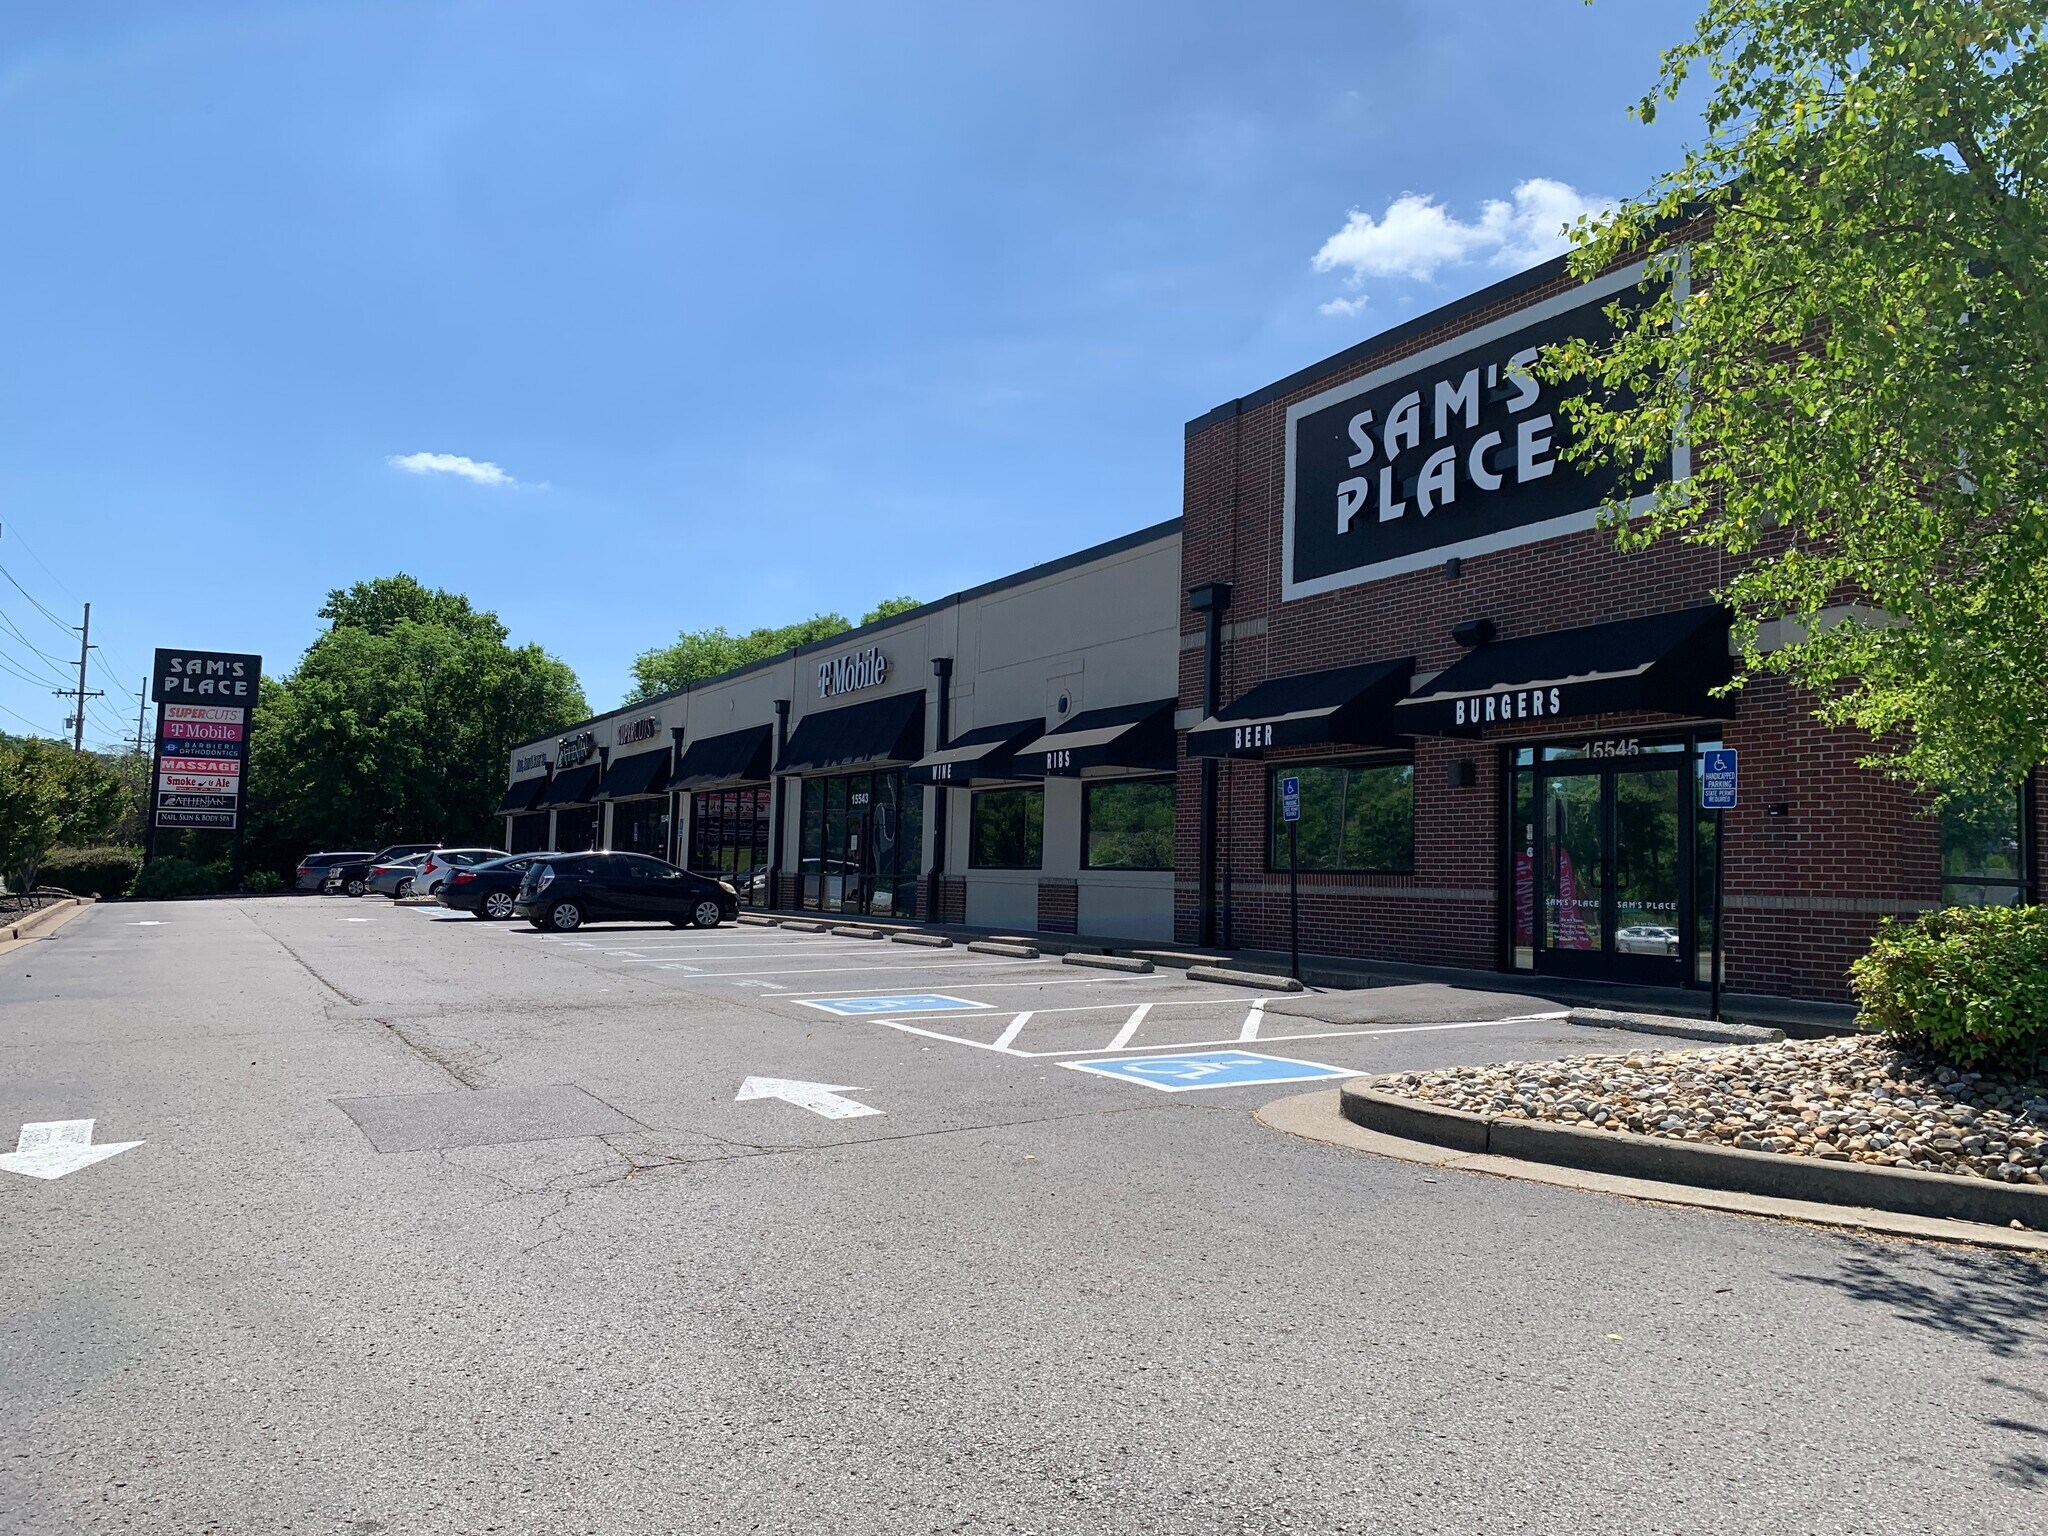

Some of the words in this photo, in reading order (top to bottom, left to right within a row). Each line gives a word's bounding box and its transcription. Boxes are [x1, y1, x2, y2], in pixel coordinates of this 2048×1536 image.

[1348, 346, 1540, 469] SAM'S
[1337, 413, 1556, 534] PLACE
[170, 658, 245, 677] SAM'S
[164, 677, 248, 696] PLACE
[168, 707, 238, 721] SUPERCUTS
[1456, 687, 1561, 725] BURGERS
[1234, 723, 1273, 750] BEER
[185, 742, 234, 750] BARBIERI
[1582, 739, 1639, 758] 15545
[162, 760, 239, 772] MASSAGE
[1047, 750, 1070, 769] RIBS
[932, 764, 952, 780] WINE
[1706, 772, 1735, 780] HANDICAPPED
[167, 776, 196, 786] Smoke
[215, 778, 230, 787] Ale
[852, 792, 869, 805] 15543
[1572, 899, 1599, 908] PLACE
[1617, 900, 1643, 909] SAM'S
[1646, 902, 1676, 910] PLACE
